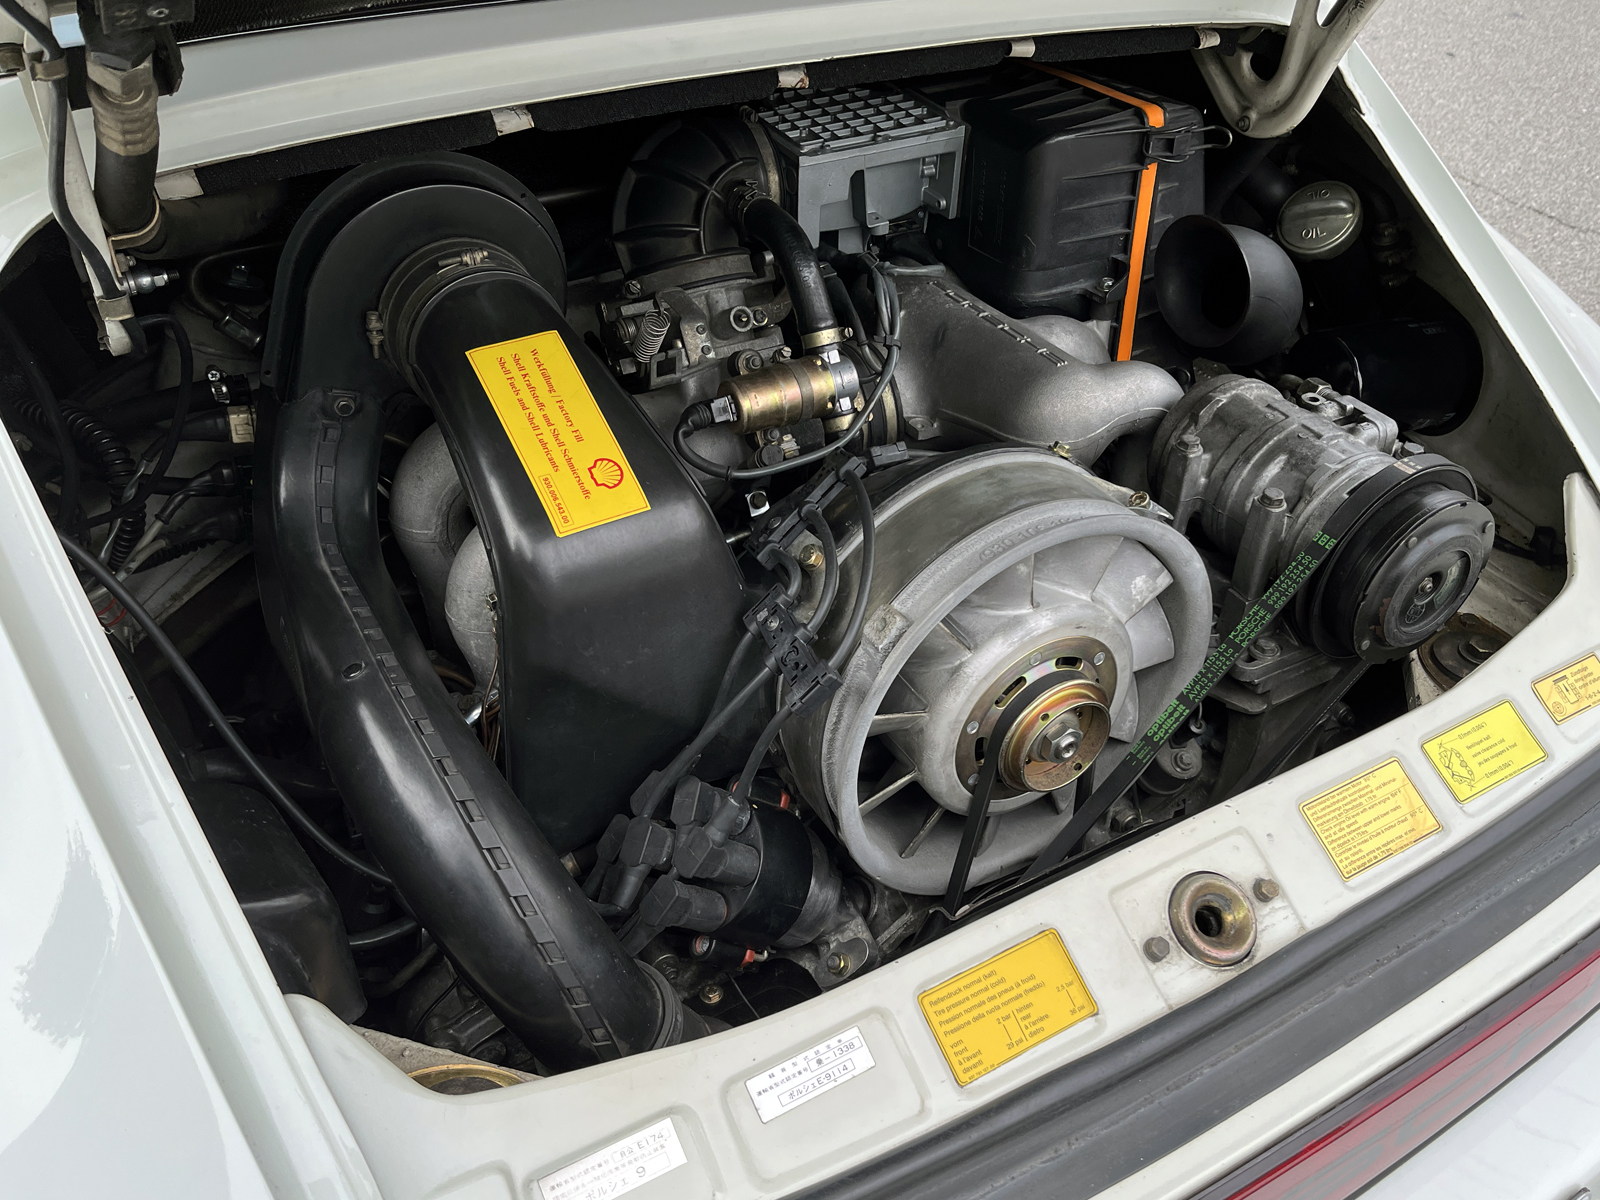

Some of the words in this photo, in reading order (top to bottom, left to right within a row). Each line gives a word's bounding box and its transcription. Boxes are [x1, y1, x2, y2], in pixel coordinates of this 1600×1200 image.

[1301, 226, 1327, 240] OIL
[530, 348, 556, 393] Werkfüllung
[555, 399, 574, 427] Factory
[570, 429, 584, 442] Fill
[495, 356, 512, 375] Shell
[505, 376, 520, 396] Fuels
[516, 397, 530, 411] and
[524, 411, 540, 431] Shell
[534, 432, 559, 472] Lubricants
[510, 352, 526, 371] Shell
[520, 372, 545, 411] Kraftstoffe
[541, 412, 555, 427] und
[549, 427, 566, 447] Shell
[560, 448, 591, 499] Schmierstoffe
[542, 476, 569, 524] 930.006.543.00
[1152, 703, 1186, 741] optibelt
[1187, 676, 1207, 700] AVP13
[1210, 655, 1225, 672] 1155
[1223, 647, 1233, 657] La
[1233, 607, 1266, 643] PORSCHE
[1266, 554, 1312, 604] 999.192.254.50
[1146, 698, 1179, 736] optibelt
[928, 986, 962, 1007] Reifendruck
[962, 976, 982, 990] normal
[981, 968, 997, 980] (kalt)
[1064, 979, 1074, 987] bar
[933, 1007, 945, 1017] Tire
[945, 996, 969, 1012] pressure
[969, 984, 989, 998] normal
[988, 976, 1006, 989] (cold)
[938, 1011, 963, 1027] Pression
[962, 999, 986, 1014] normale
[985, 993, 997, 1002] des
[996, 984, 1014, 998] pneus
[1020, 972, 1036, 985] froid)
[943, 1019, 971, 1037] Pressione
[971, 1012, 985, 1023] della
[984, 1004, 1001, 1015] ruota
[1000, 992, 1023, 1007] normale
[1022, 980, 1045, 996] (freddo)
[1015, 1001, 1033, 1014] hinten
[1076, 1003, 1085, 1011] psi
[1000, 1012, 1011, 1021] bar
[1019, 1012, 1031, 1022] rear
[1027, 1025, 1045, 1038] dietro
[949, 1038, 963, 1049] vorn
[1005, 1041, 1015, 1050] 29
[1013, 1036, 1024, 1046] psi
[953, 1045, 968, 1057] front
[961, 1058, 983, 1074] davanti
[635, 1165, 646, 1178] 9
